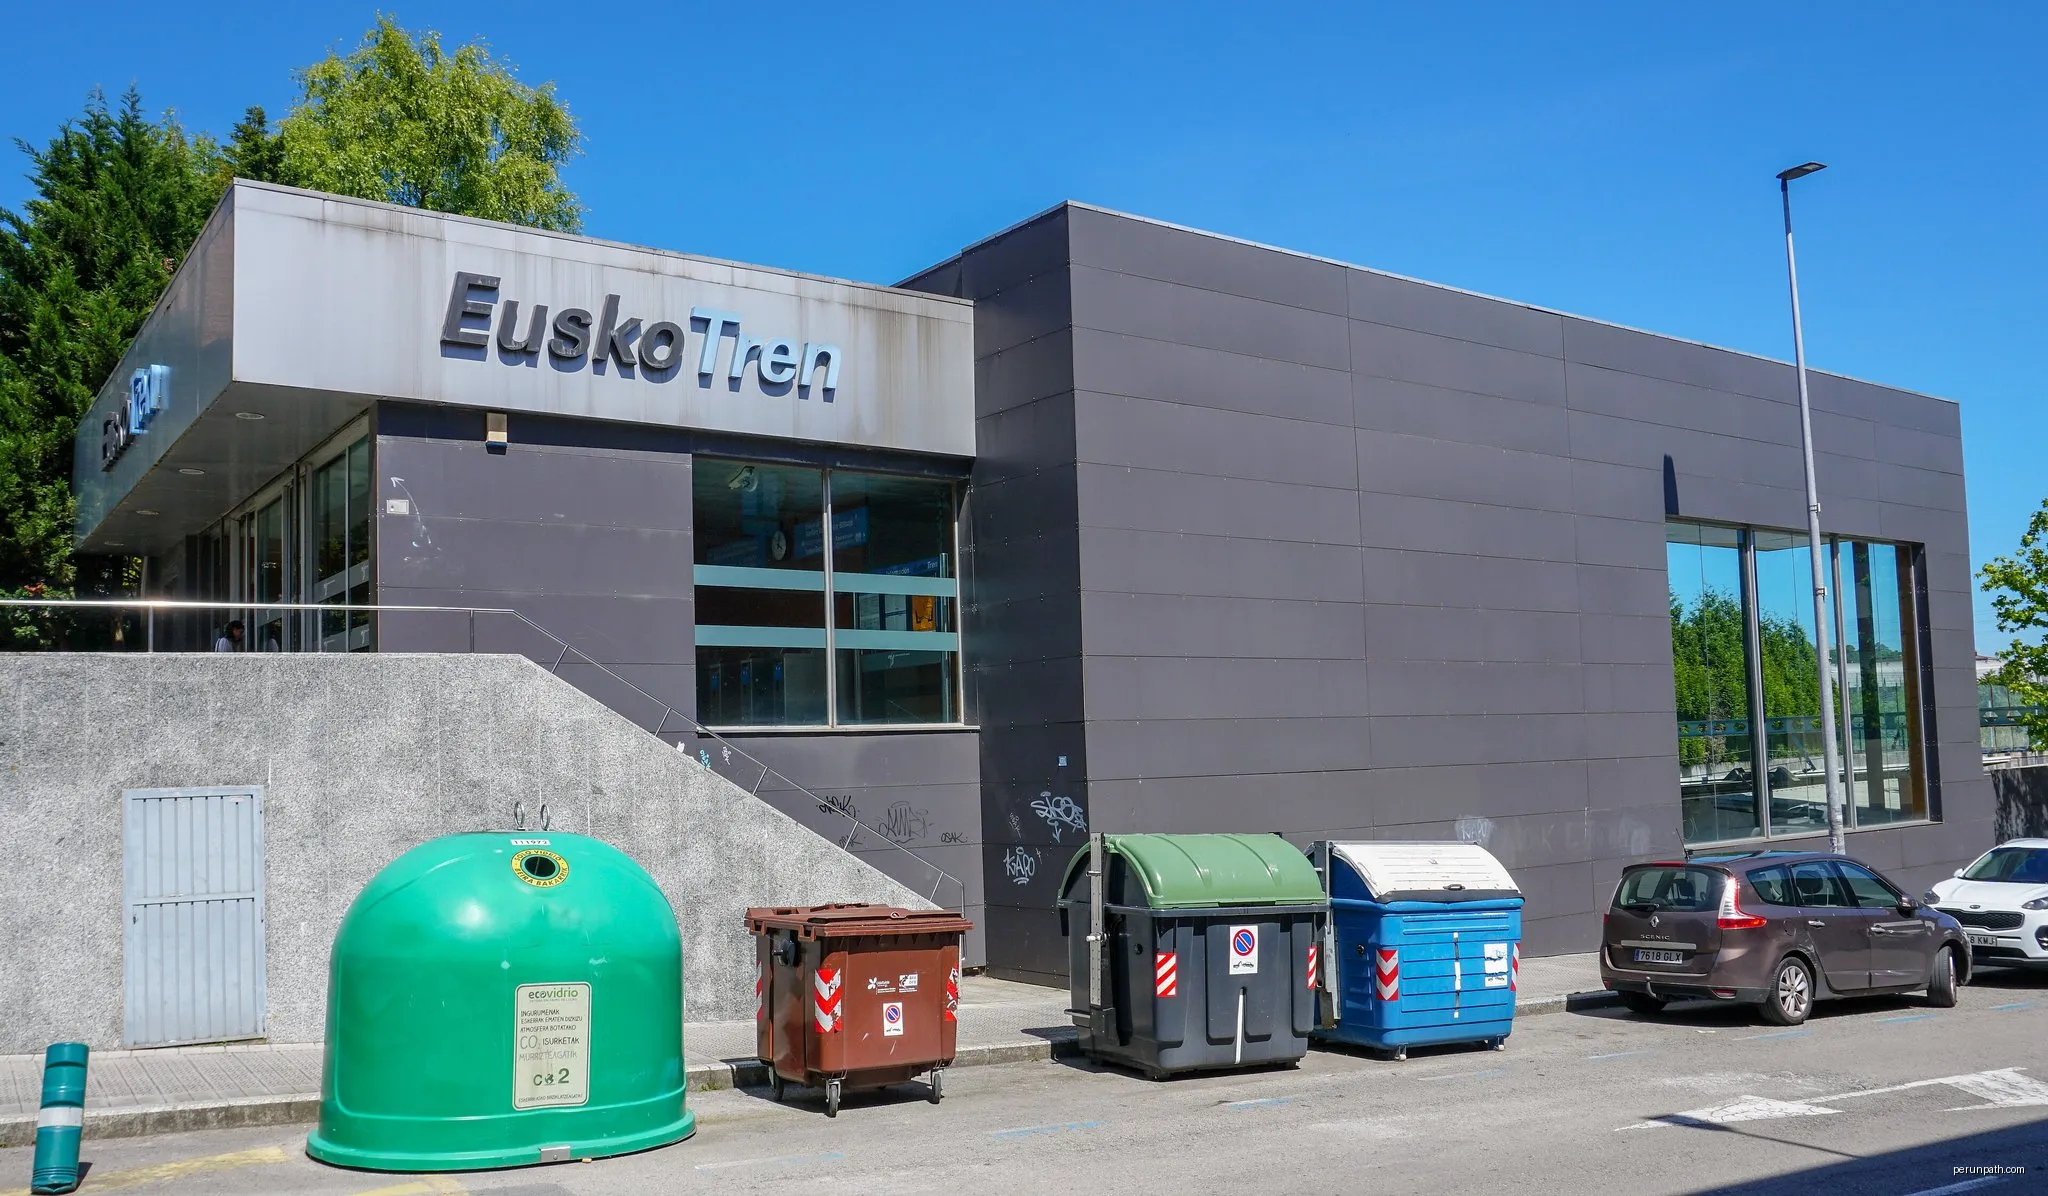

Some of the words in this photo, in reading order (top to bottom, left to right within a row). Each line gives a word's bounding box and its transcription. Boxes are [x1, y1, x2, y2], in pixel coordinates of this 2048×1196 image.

[440, 271, 842, 389] EuskoTren
[1640, 950, 1661, 961] 7618
[1663, 952, 1681, 962] GLX
[528, 987, 579, 999] ecovidrio
[542, 1037, 580, 1046] ISURKETAK
